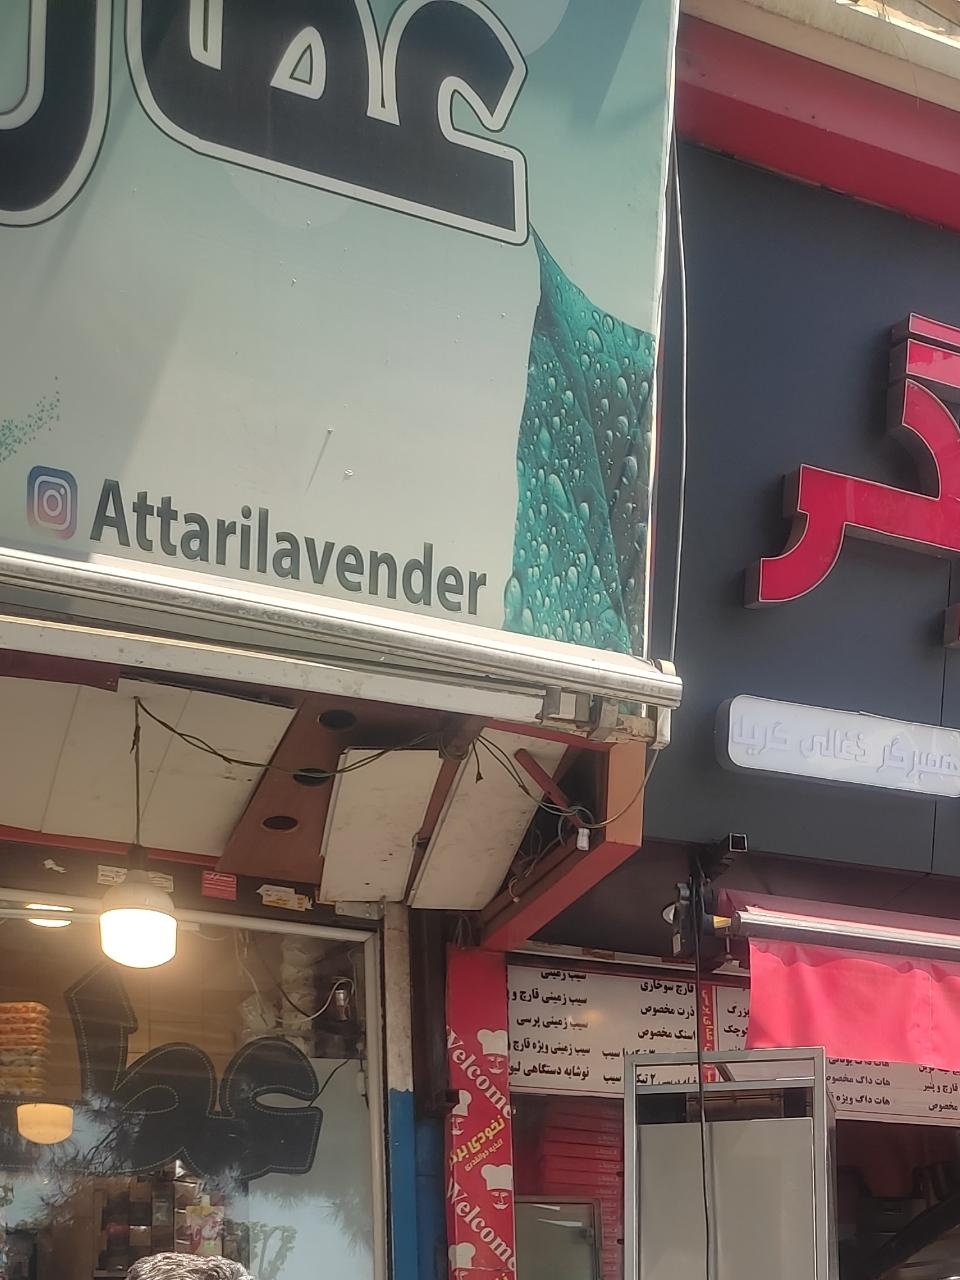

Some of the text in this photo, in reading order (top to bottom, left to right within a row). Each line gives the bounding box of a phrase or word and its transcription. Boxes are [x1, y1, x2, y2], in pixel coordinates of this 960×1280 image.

[90, 479, 487, 616] Attarilavender
[519, 987, 540, 1001] قارچ
[640, 979, 694, 995] قارچ سوخاری
[541, 990, 567, 1005] زمینی
[569, 994, 588, 1005] سیب
[640, 1004, 695, 1019] ذرت مخصوص
[517, 1015, 588, 1029] سیب زمینی پرسی
[638, 1026, 672, 1039] مخصوص
[513, 1037, 530, 1051] قارچ
[551, 1041, 574, 1056] زمینی
[574, 1044, 591, 1055] سیب
[523, 1062, 562, 1077] دستگاهی
[564, 1064, 590, 1080] نوشابه
[874, 1076, 891, 1087] هات
[942, 1083, 959, 1094] قارچ
[874, 1095, 891, 1106] هات
[928, 1101, 958, 1112] مخصوص
[467, 1114, 506, 1156] نخودی
